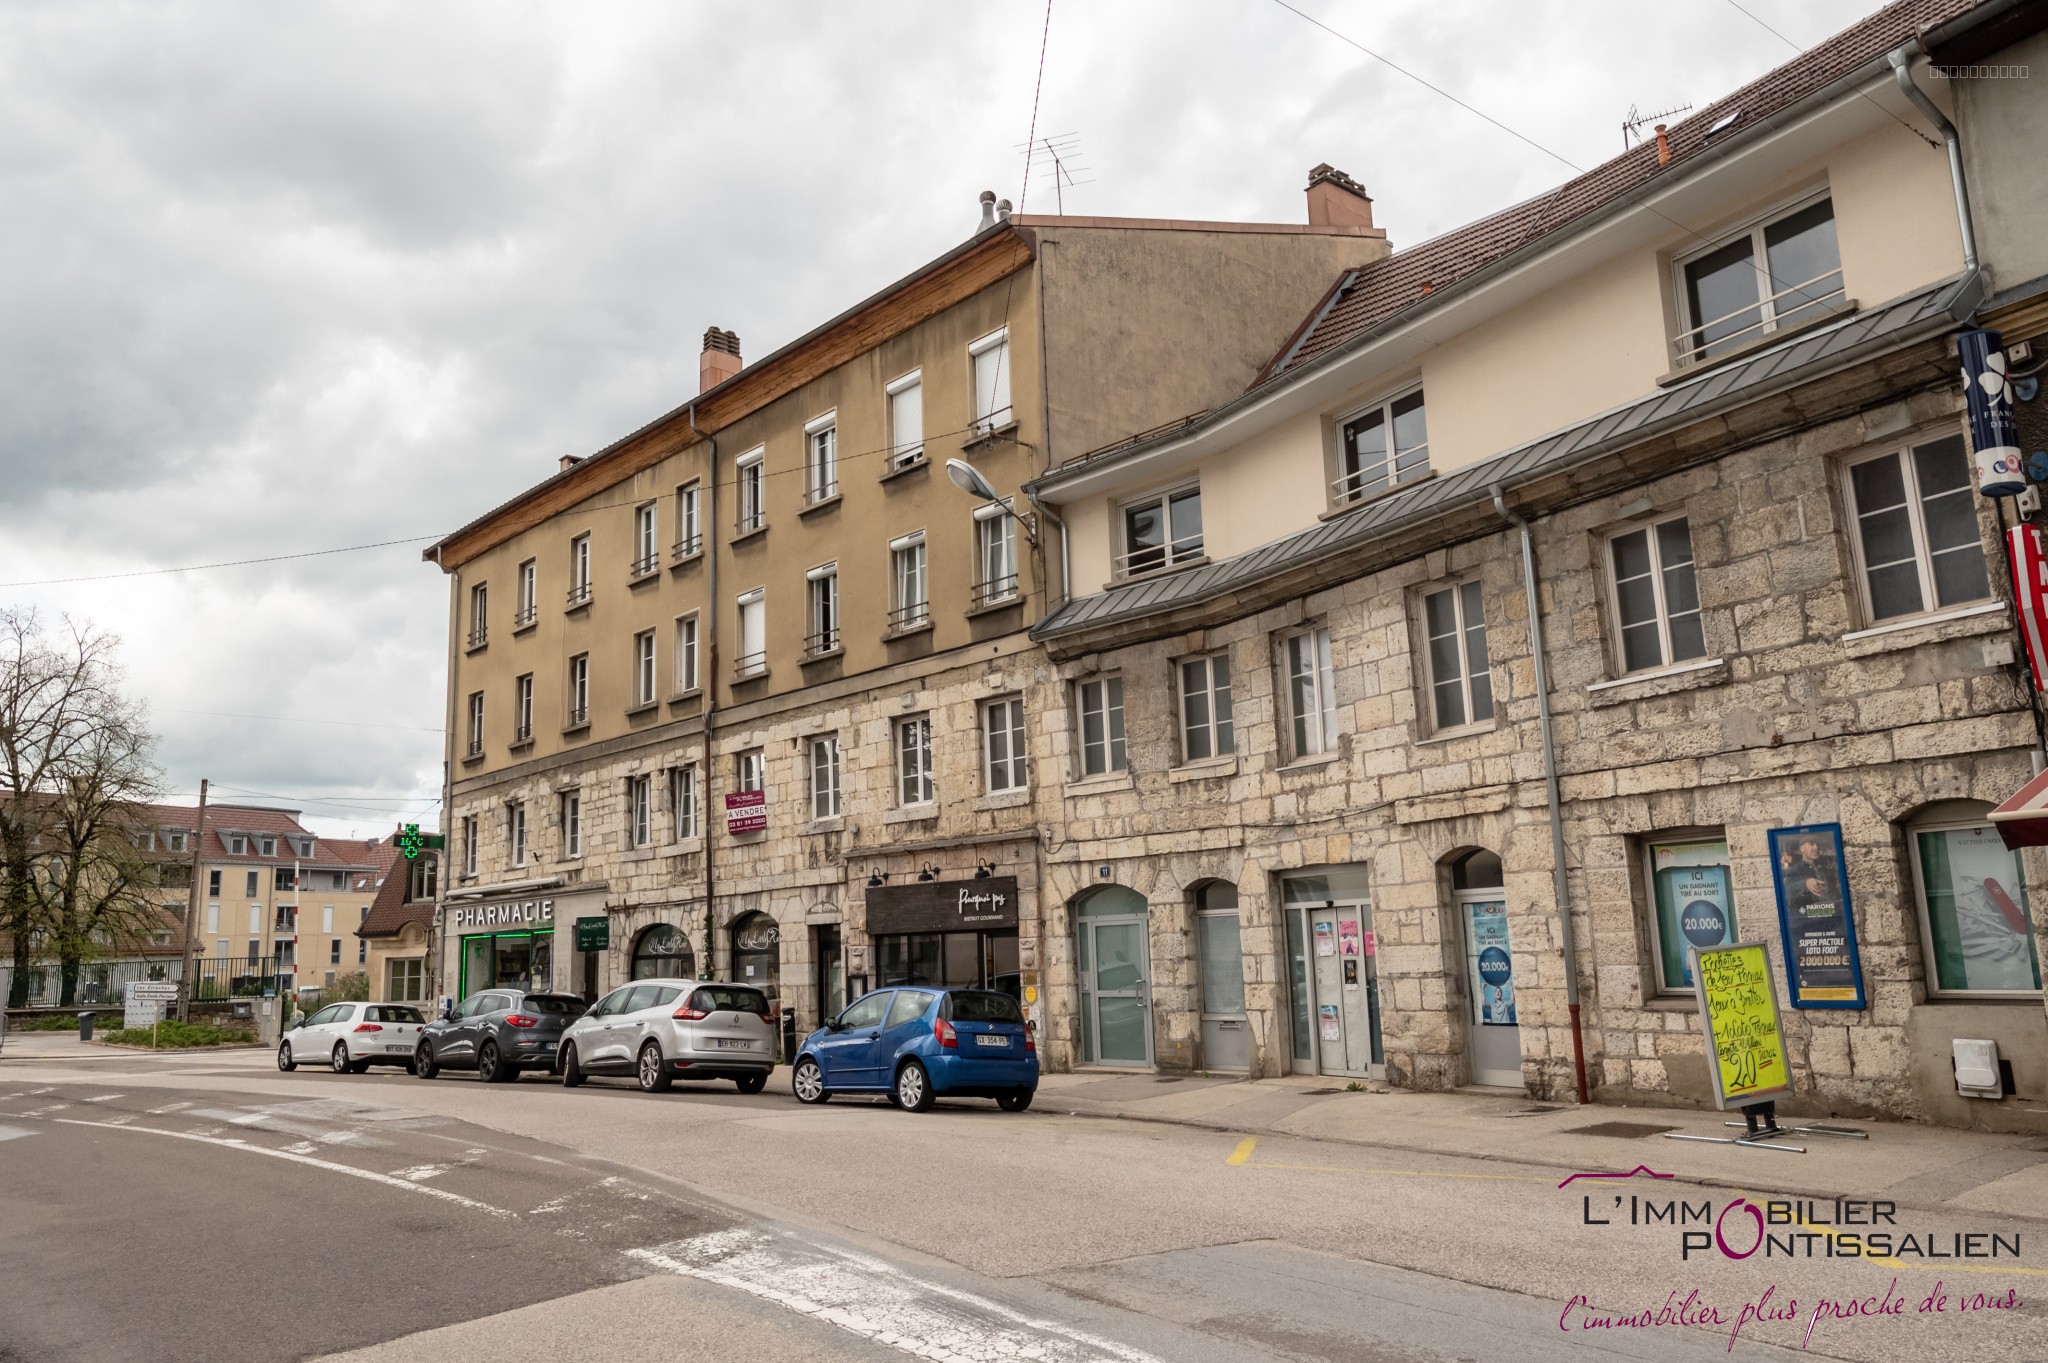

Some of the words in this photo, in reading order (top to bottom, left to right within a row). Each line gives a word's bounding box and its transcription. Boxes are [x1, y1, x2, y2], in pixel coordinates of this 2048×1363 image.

[1991, 420, 2009, 429] DES
[735, 806, 764, 817] VENDRE
[1958, 837, 2002, 846] VICTORINOX
[1691, 871, 1704, 881] ICI
[455, 900, 553, 926] PHARMACIE
[1685, 917, 1723, 930] 20.000€
[1799, 939, 1817, 947] SUPER
[1818, 937, 1845, 946] PACTOLE
[1806, 946, 1821, 955] LOTO
[1730, 1050, 1757, 1087] 20
